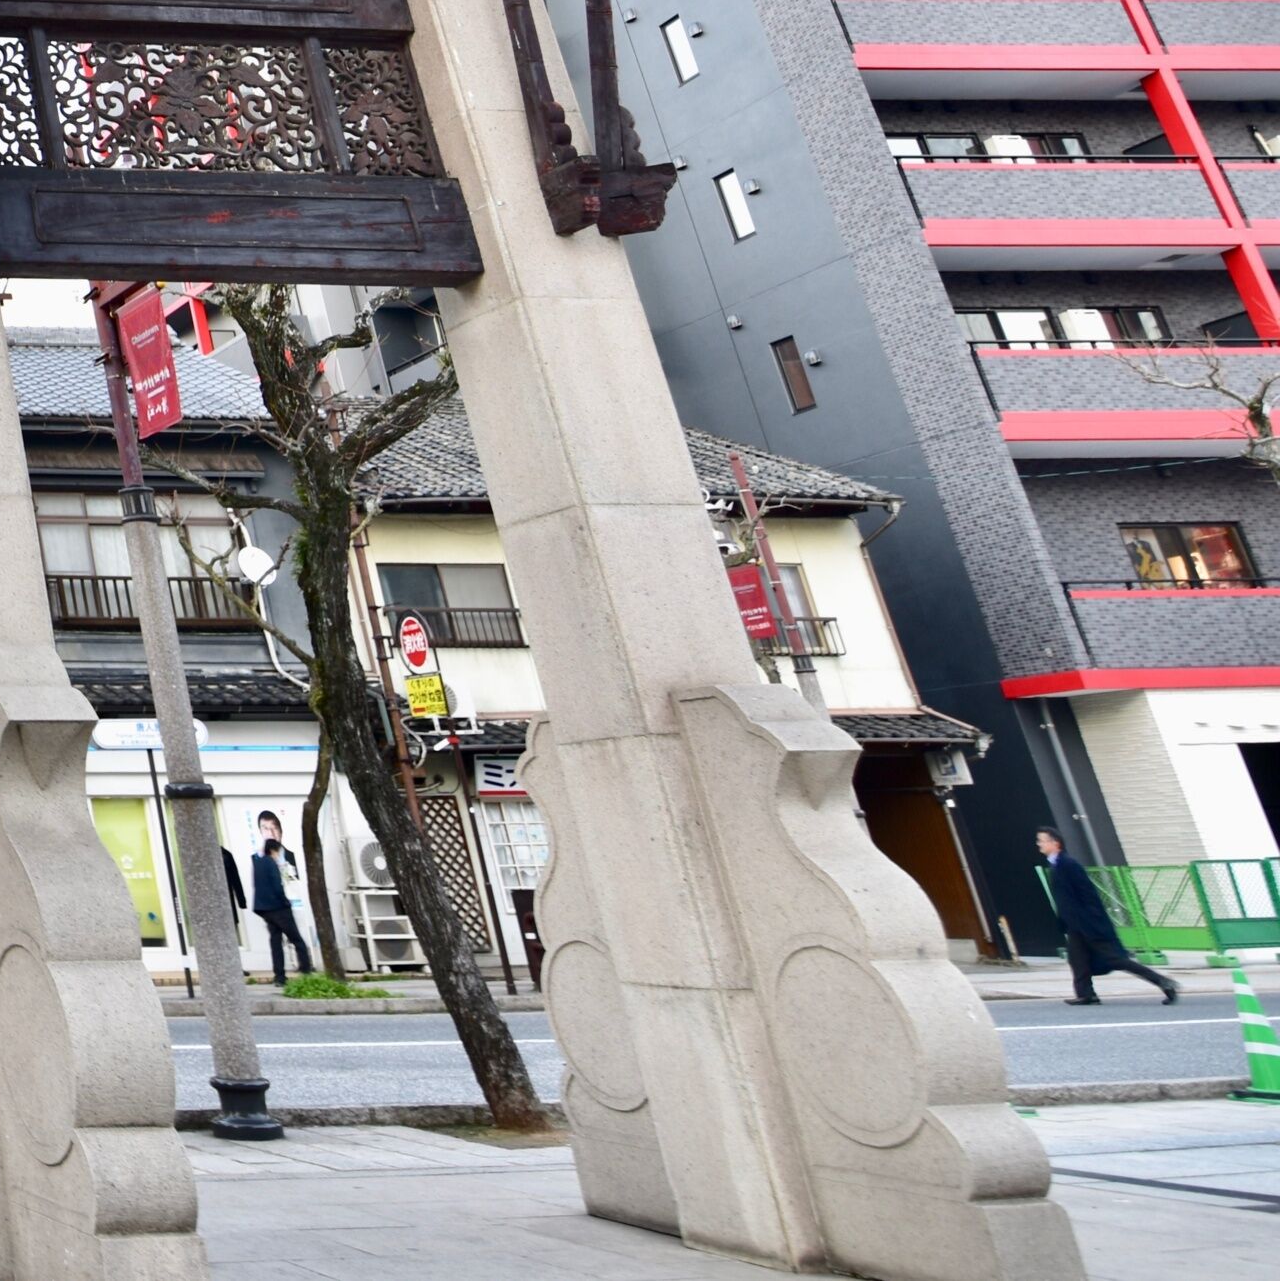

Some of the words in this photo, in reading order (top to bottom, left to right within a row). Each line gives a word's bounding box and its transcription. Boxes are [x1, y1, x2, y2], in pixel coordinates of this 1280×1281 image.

[404, 633, 426, 653] 消火栓
[409, 690, 443, 704] つりがね堂
